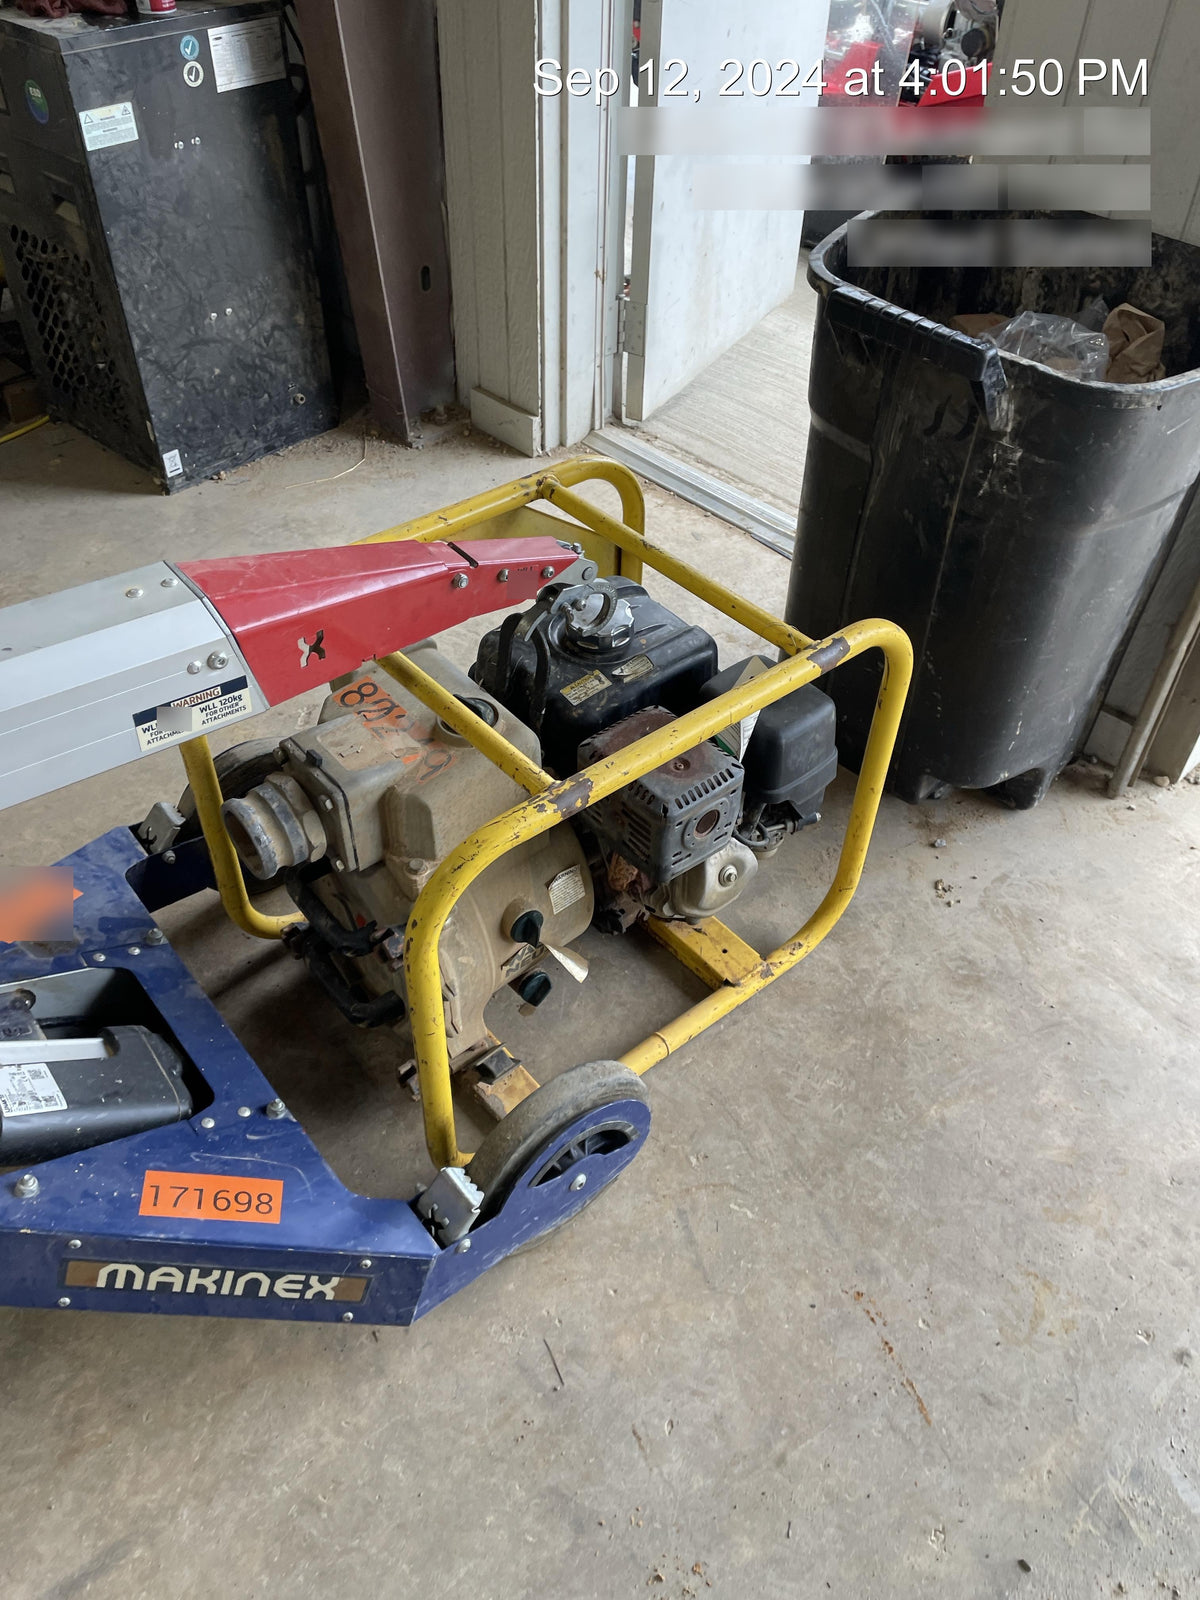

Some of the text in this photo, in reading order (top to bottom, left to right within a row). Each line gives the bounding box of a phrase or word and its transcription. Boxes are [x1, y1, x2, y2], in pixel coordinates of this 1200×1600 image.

[172, 687, 221, 708] WARNING
[198, 693, 243, 714] WLL 120kg
[201, 705, 247, 726] ATTACHMENTS
[205, 702, 240, 718] FOR OTHER
[149, 1184, 274, 1215] 171698
[96, 1262, 340, 1301] MAKINEX
